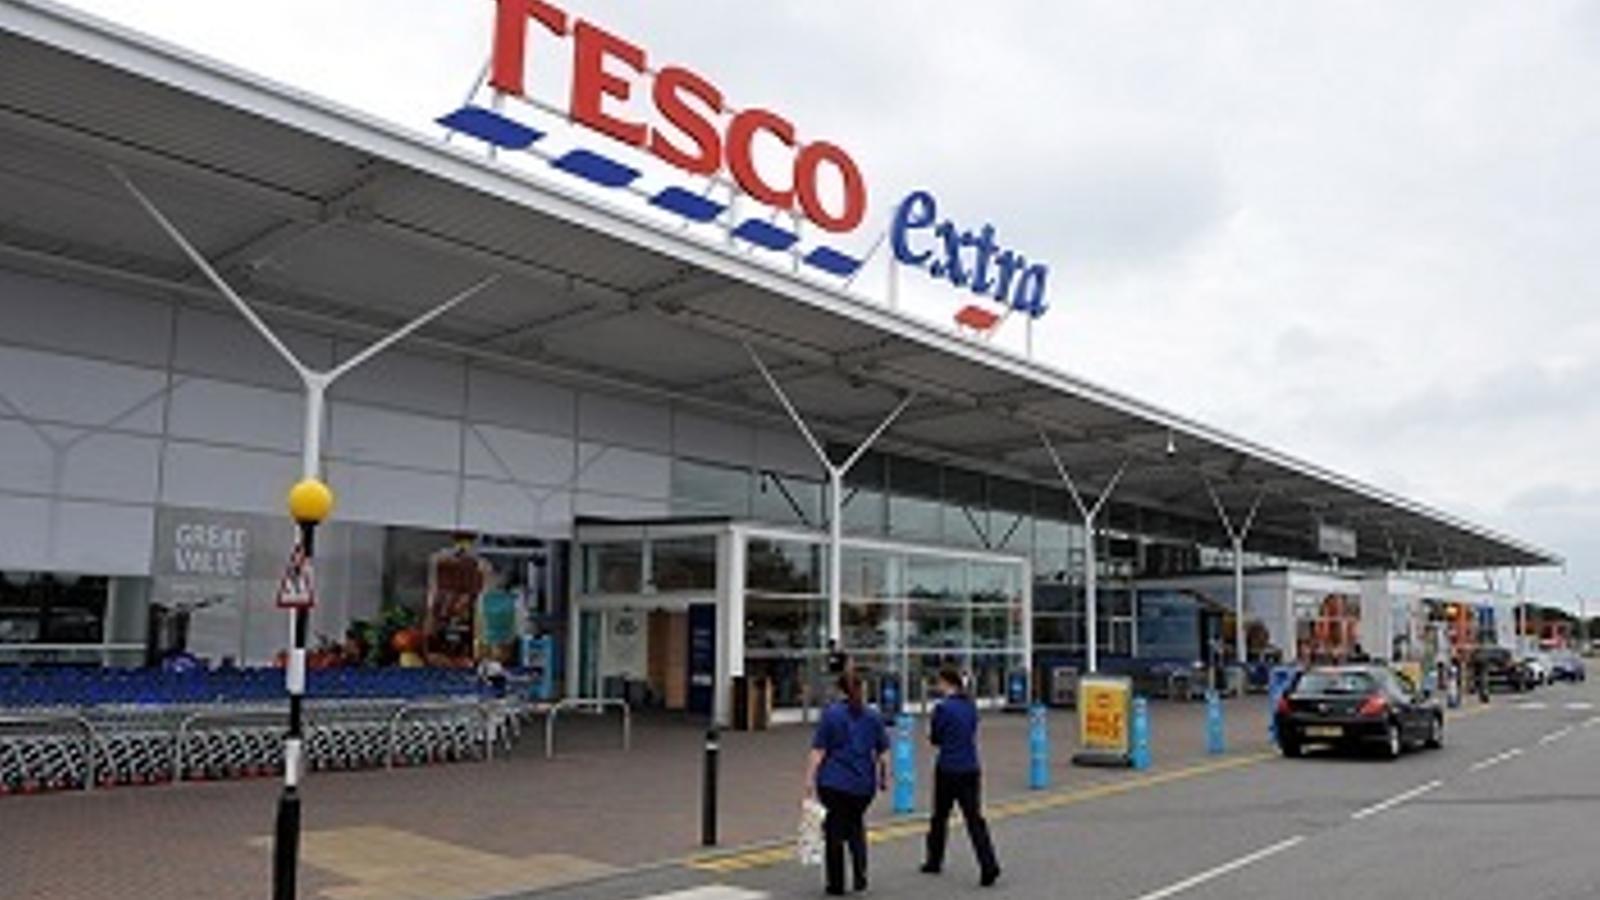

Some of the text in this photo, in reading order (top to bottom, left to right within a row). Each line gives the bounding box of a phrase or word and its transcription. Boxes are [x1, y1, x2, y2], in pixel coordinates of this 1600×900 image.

[489, 0, 1048, 319] TESCO extra
[175, 523, 247, 549] GREAT
[174, 547, 244, 577] VALUE
